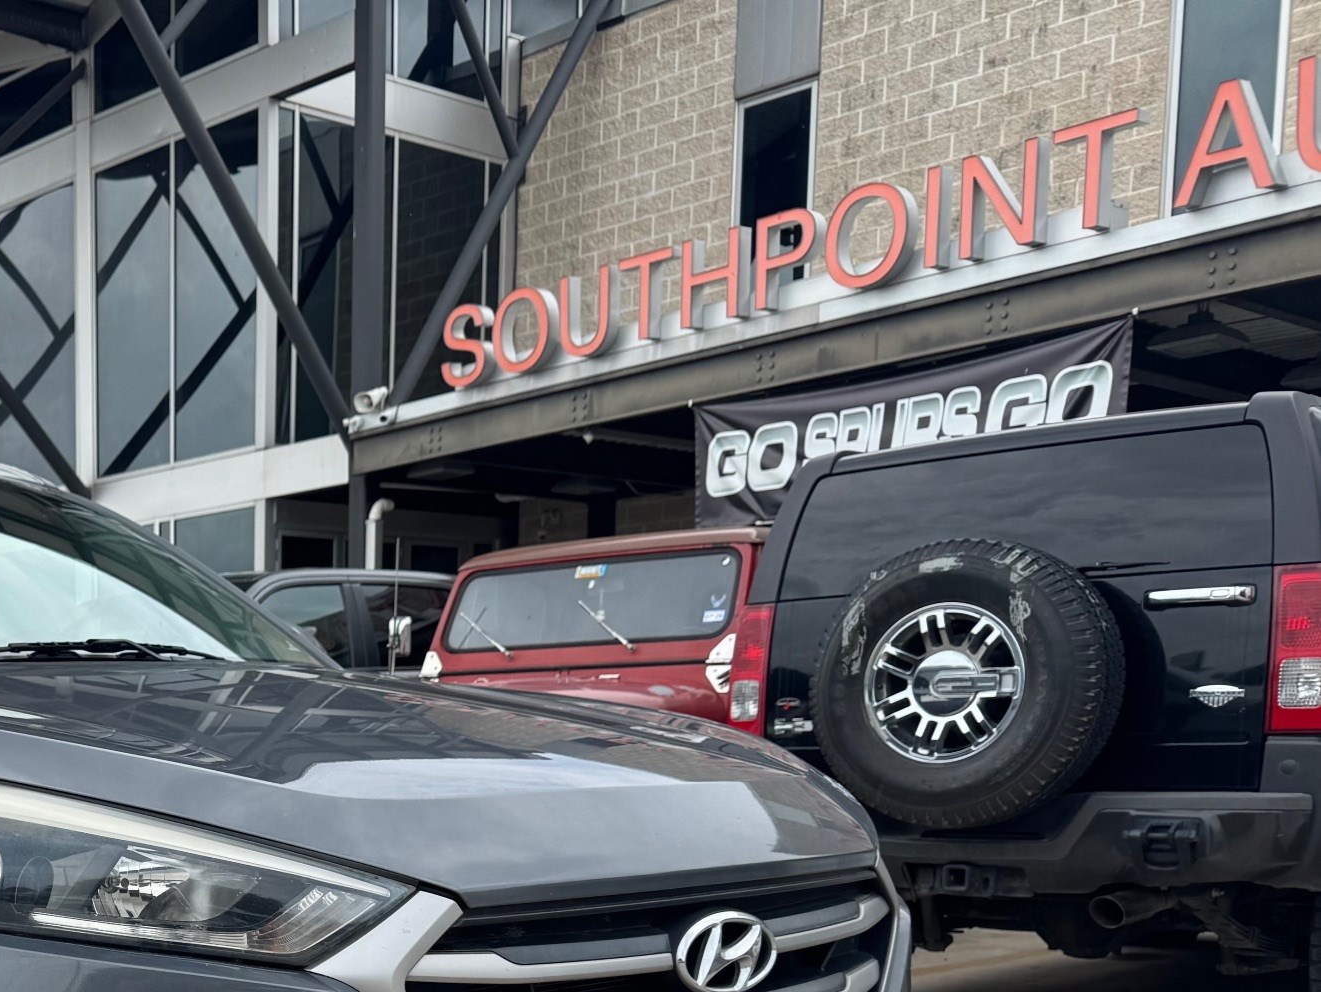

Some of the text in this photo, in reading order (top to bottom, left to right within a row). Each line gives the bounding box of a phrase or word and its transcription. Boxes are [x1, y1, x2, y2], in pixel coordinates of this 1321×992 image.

[441, 108, 1141, 388] SOUTHPOINT
[706, 359, 1114, 498] GO SPURS GO
